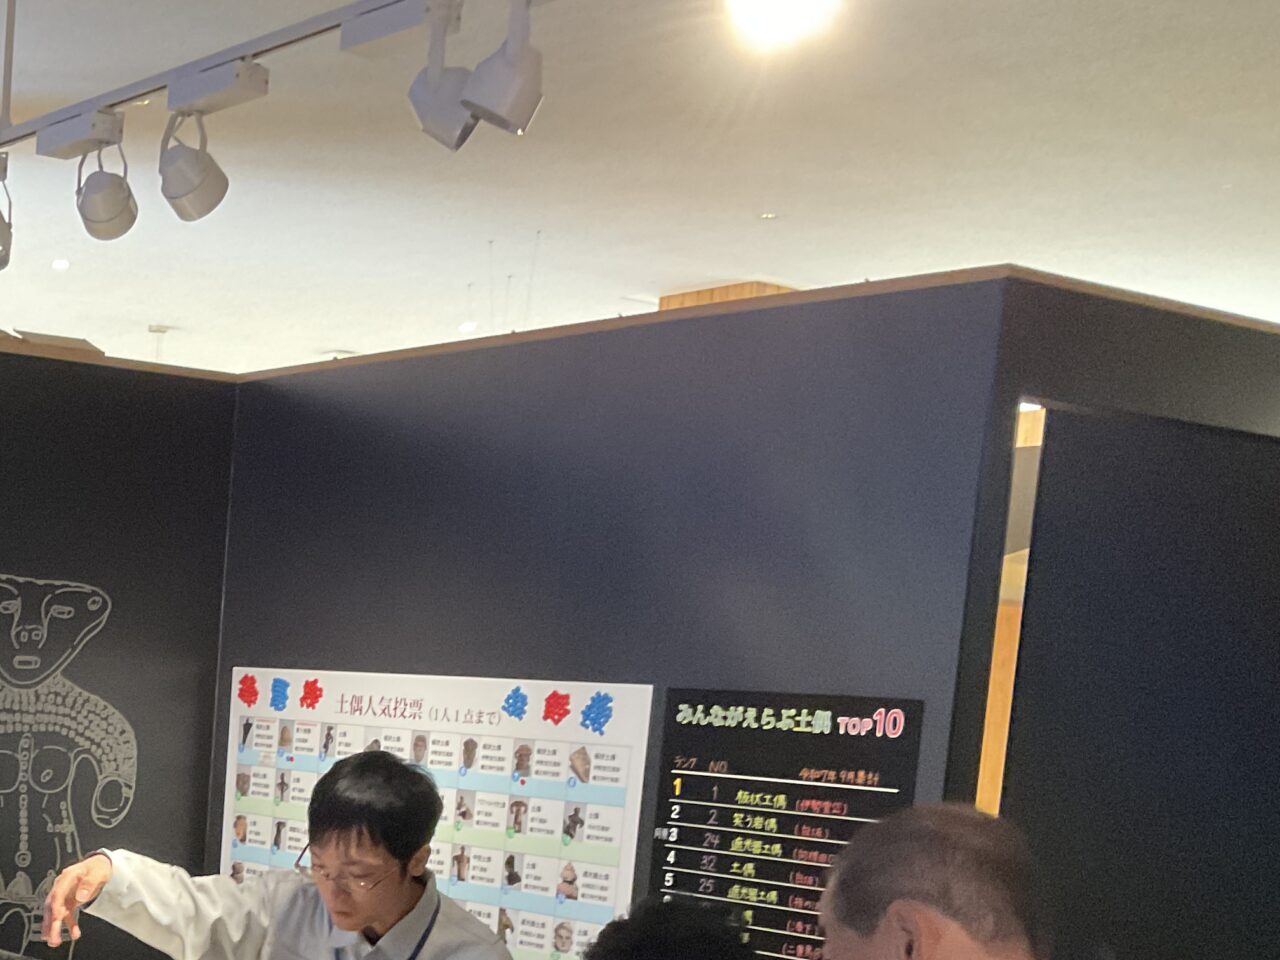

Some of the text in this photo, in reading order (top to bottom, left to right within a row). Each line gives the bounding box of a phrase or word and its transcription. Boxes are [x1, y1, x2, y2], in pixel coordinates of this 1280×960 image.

[334, 694, 424, 721] 土偶人気投票
[676, 704, 906, 738] みんながえらぶ土偶 TOP10
[673, 778, 683, 796] 1
[670, 804, 681, 819] 2
[707, 809, 718, 825] 2
[668, 827, 678, 842] 3
[702, 833, 720, 849] 24
[666, 850, 676, 865] 4
[700, 855, 717, 871] 32
[729, 862, 756, 878] 土偶
[664, 873, 674, 887] 5
[698, 878, 714, 893] 25
